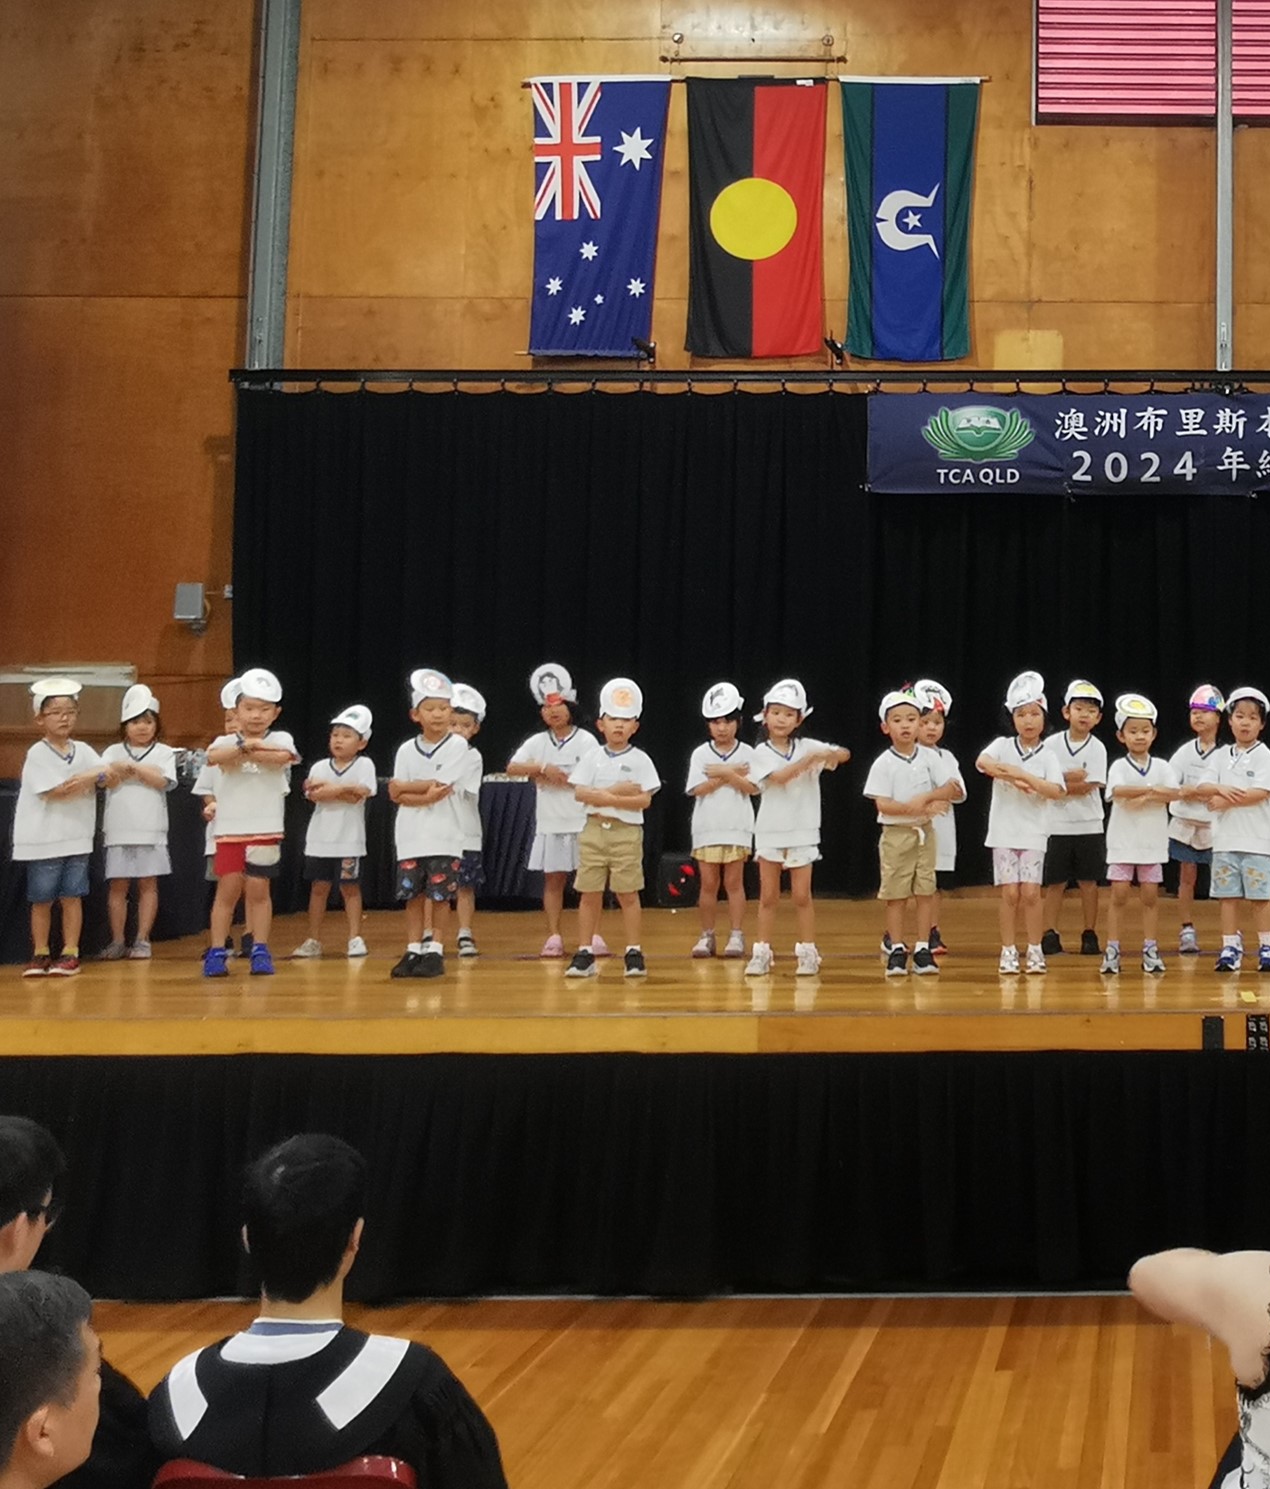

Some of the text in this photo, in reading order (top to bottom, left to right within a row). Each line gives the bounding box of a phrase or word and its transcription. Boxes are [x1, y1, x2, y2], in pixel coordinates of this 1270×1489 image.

[936, 468, 1020, 485] TCA QLD
[1071, 450, 1197, 483] 2024
